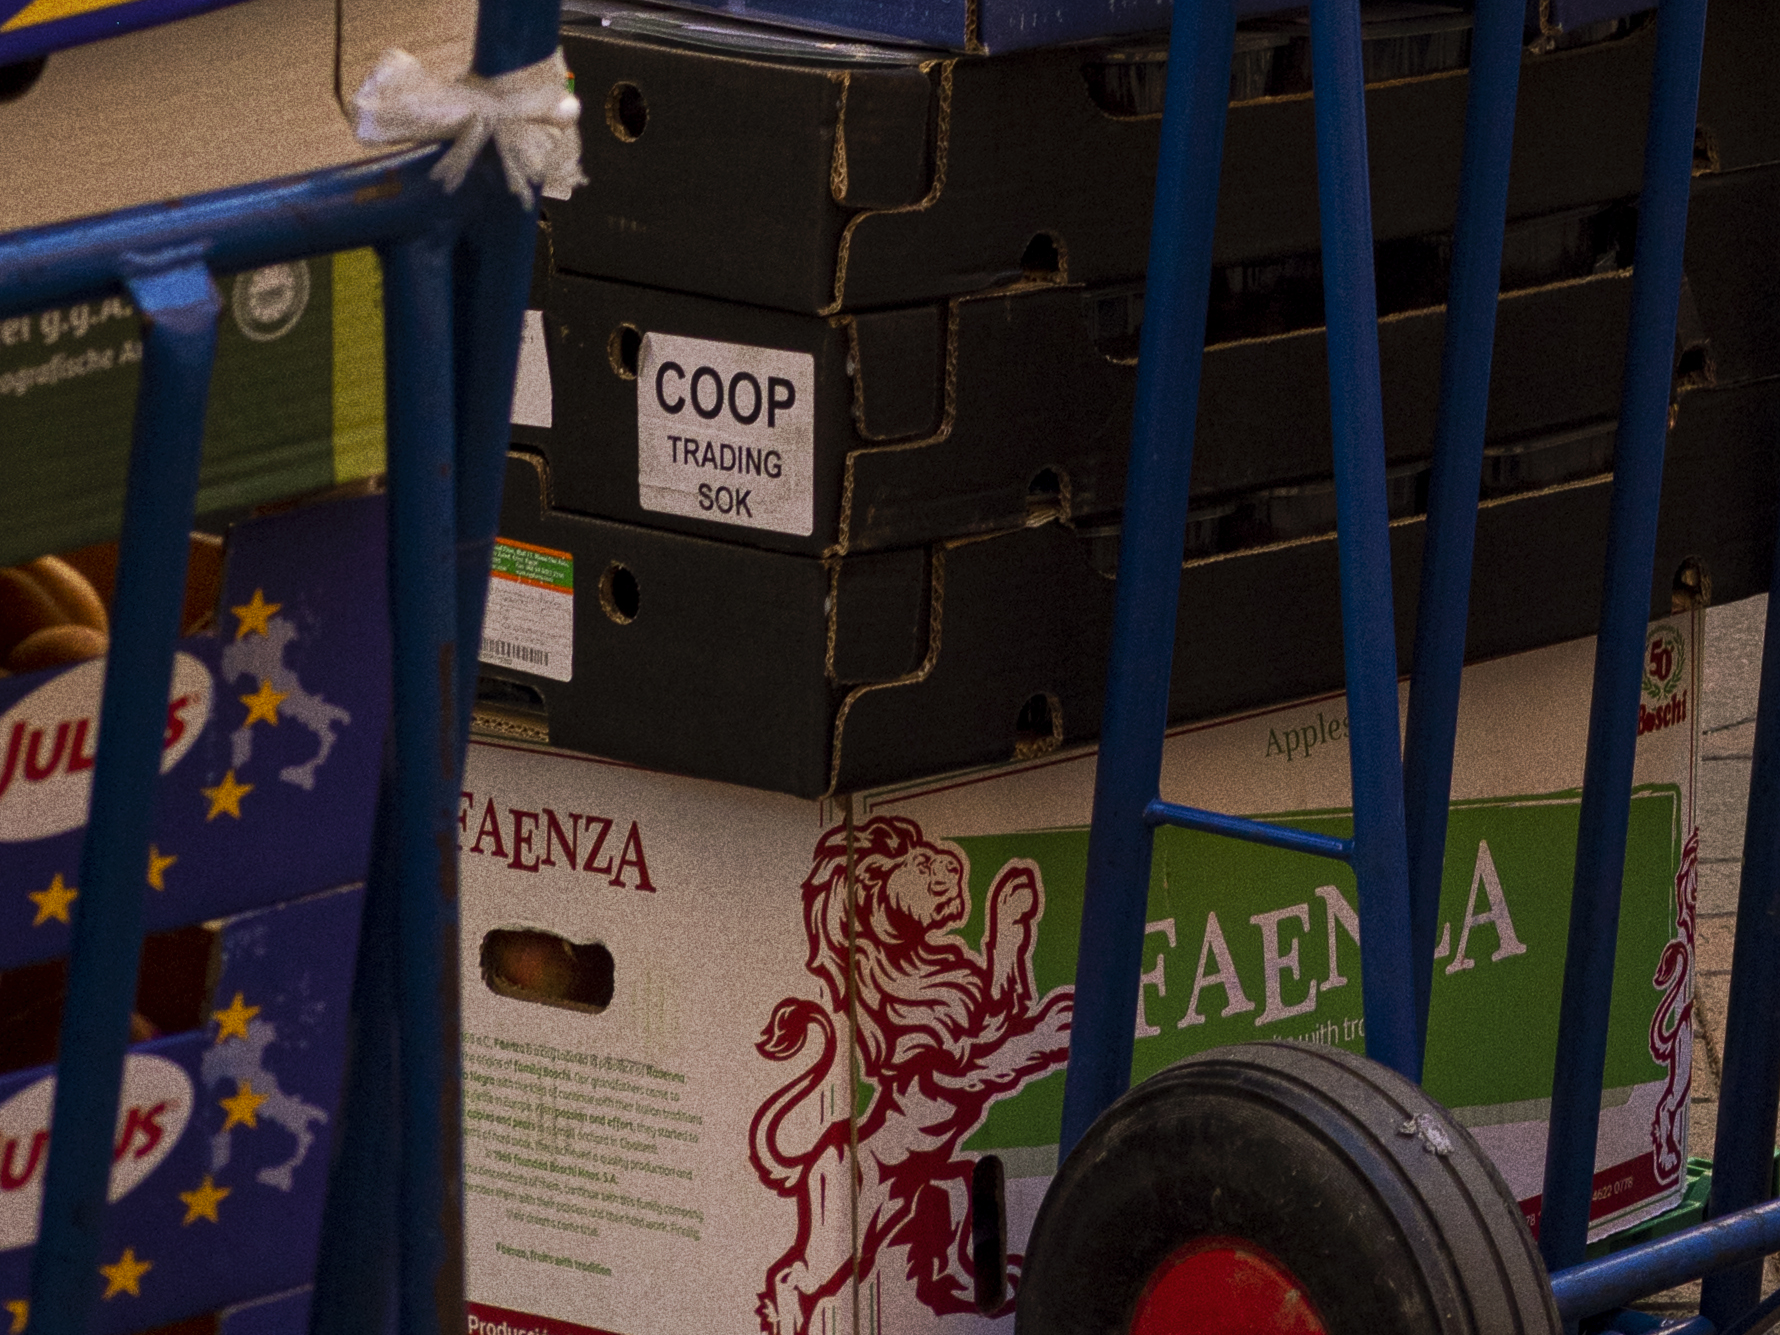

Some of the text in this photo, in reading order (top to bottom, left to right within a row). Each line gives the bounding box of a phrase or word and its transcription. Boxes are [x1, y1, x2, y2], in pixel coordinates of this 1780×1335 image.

[655, 360, 796, 429] COOP
[667, 434, 783, 480] TRADING
[698, 482, 753, 519] SOK
